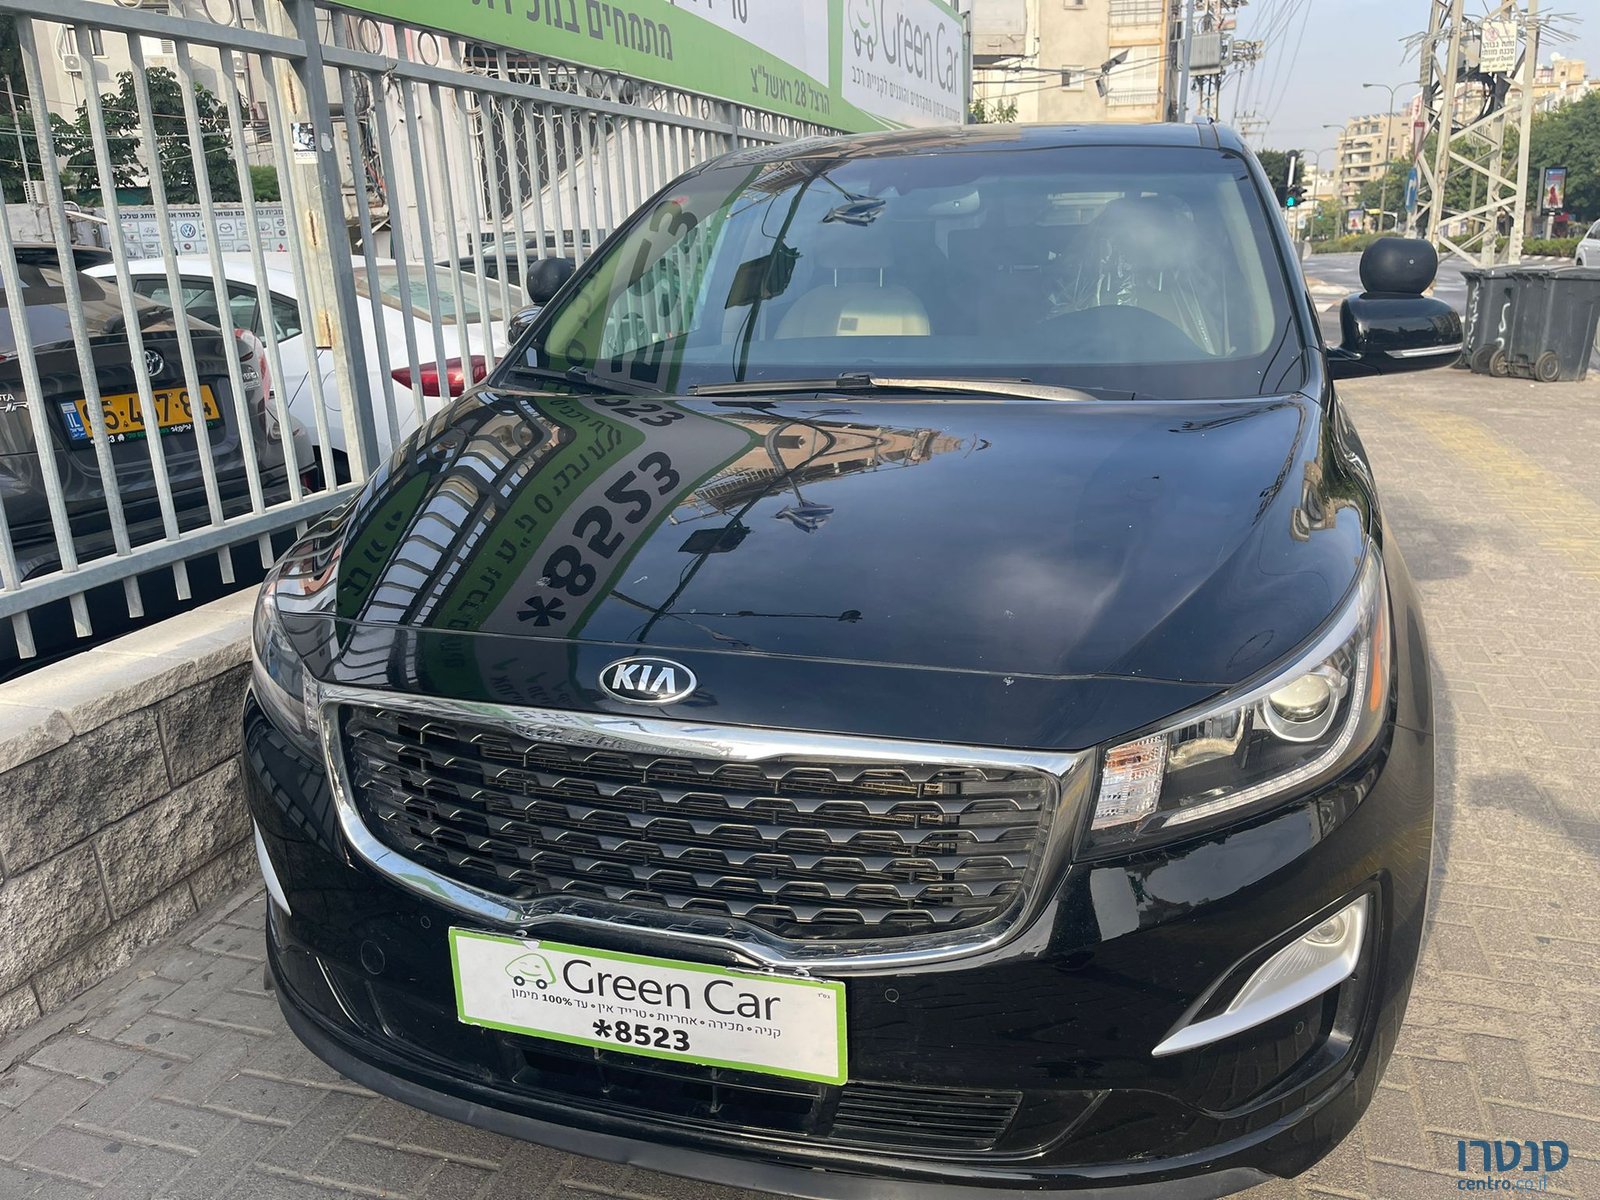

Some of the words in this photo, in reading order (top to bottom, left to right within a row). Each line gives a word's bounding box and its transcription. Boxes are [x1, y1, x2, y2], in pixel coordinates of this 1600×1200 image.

[586, 0, 674, 61] מתמחים
[880, 0, 934, 84] Green
[936, 22, 960, 95] Car
[851, 65, 866, 87] רכב
[795, 79, 808, 108] 28
[809, 87, 831, 116] הרצל
[611, 664, 677, 694] KIA
[511, 988, 539, 1000] מימון
[562, 958, 691, 1010] Green
[704, 979, 781, 1021] Car
[542, 994, 573, 1007] 100%
[574, 999, 588, 1009] עד
[597, 1002, 614, 1014] אין
[617, 1006, 647, 1019] טרייד
[656, 1011, 698, 1026] אחריות
[708, 1018, 744, 1032] מכירה
[754, 1025, 781, 1039] קניה
